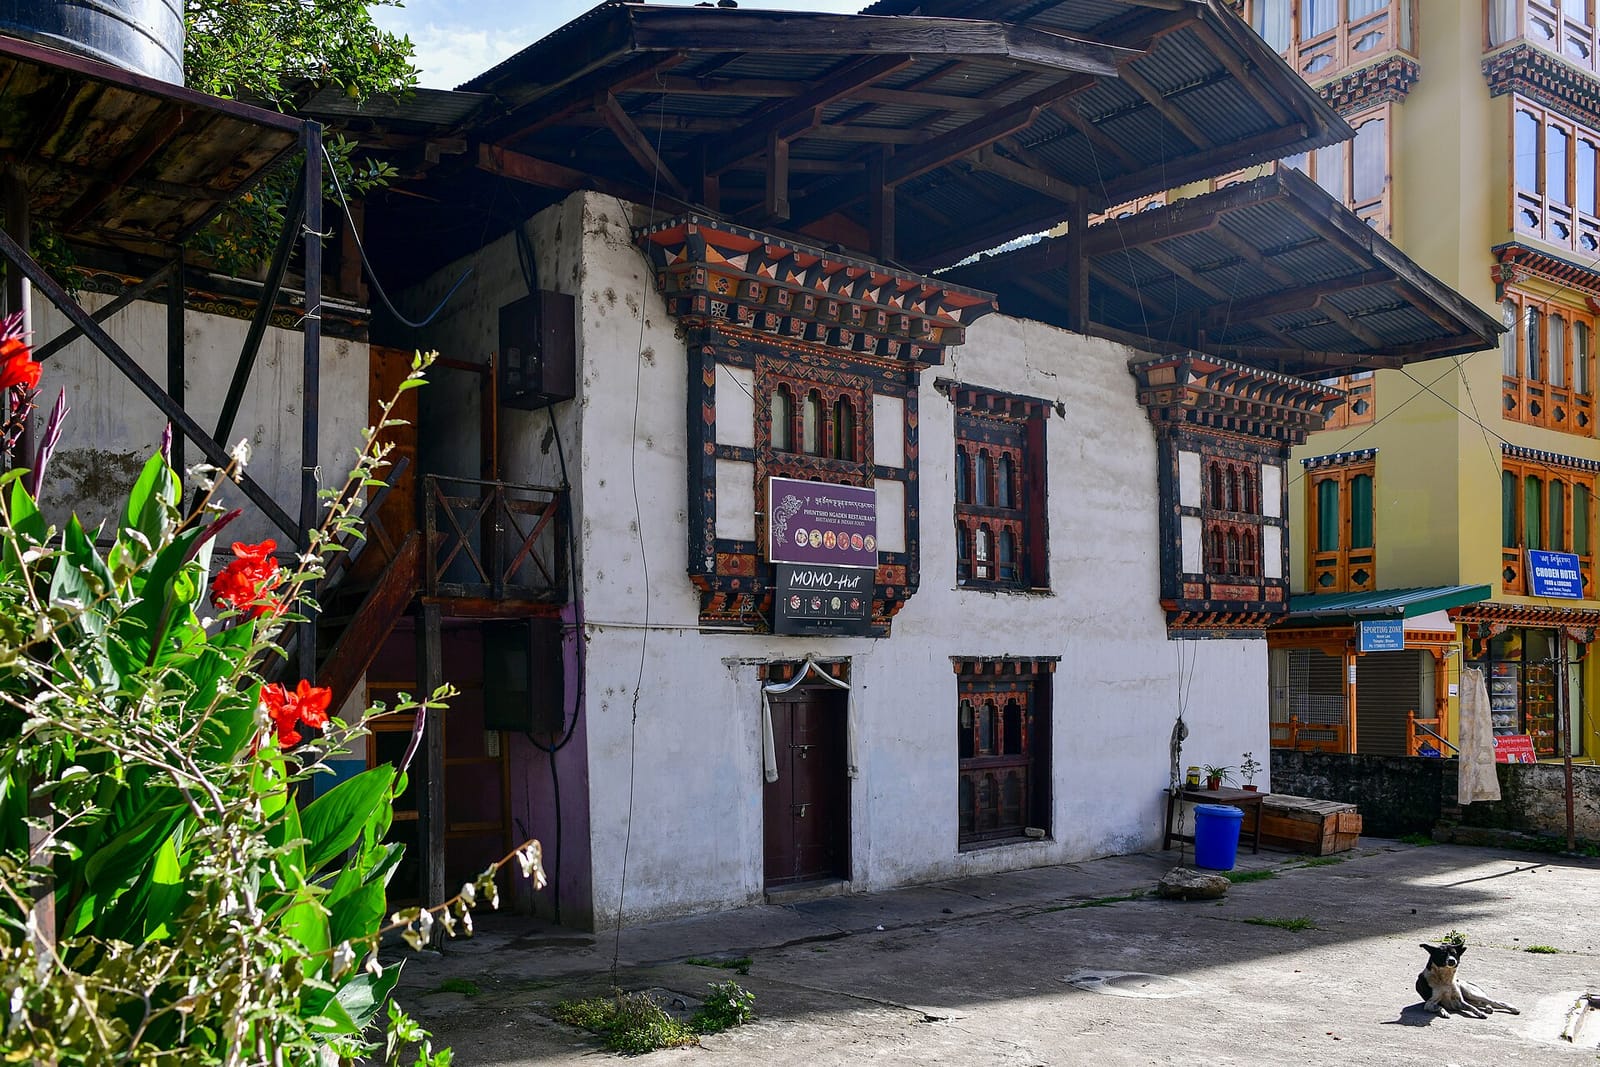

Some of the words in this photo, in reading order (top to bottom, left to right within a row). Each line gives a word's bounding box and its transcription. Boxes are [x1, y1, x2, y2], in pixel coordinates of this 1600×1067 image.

[1535, 567, 1559, 579] CHODEN
[1560, 569, 1578, 580] HOTEL
[1389, 625, 1402, 633] ZONE
